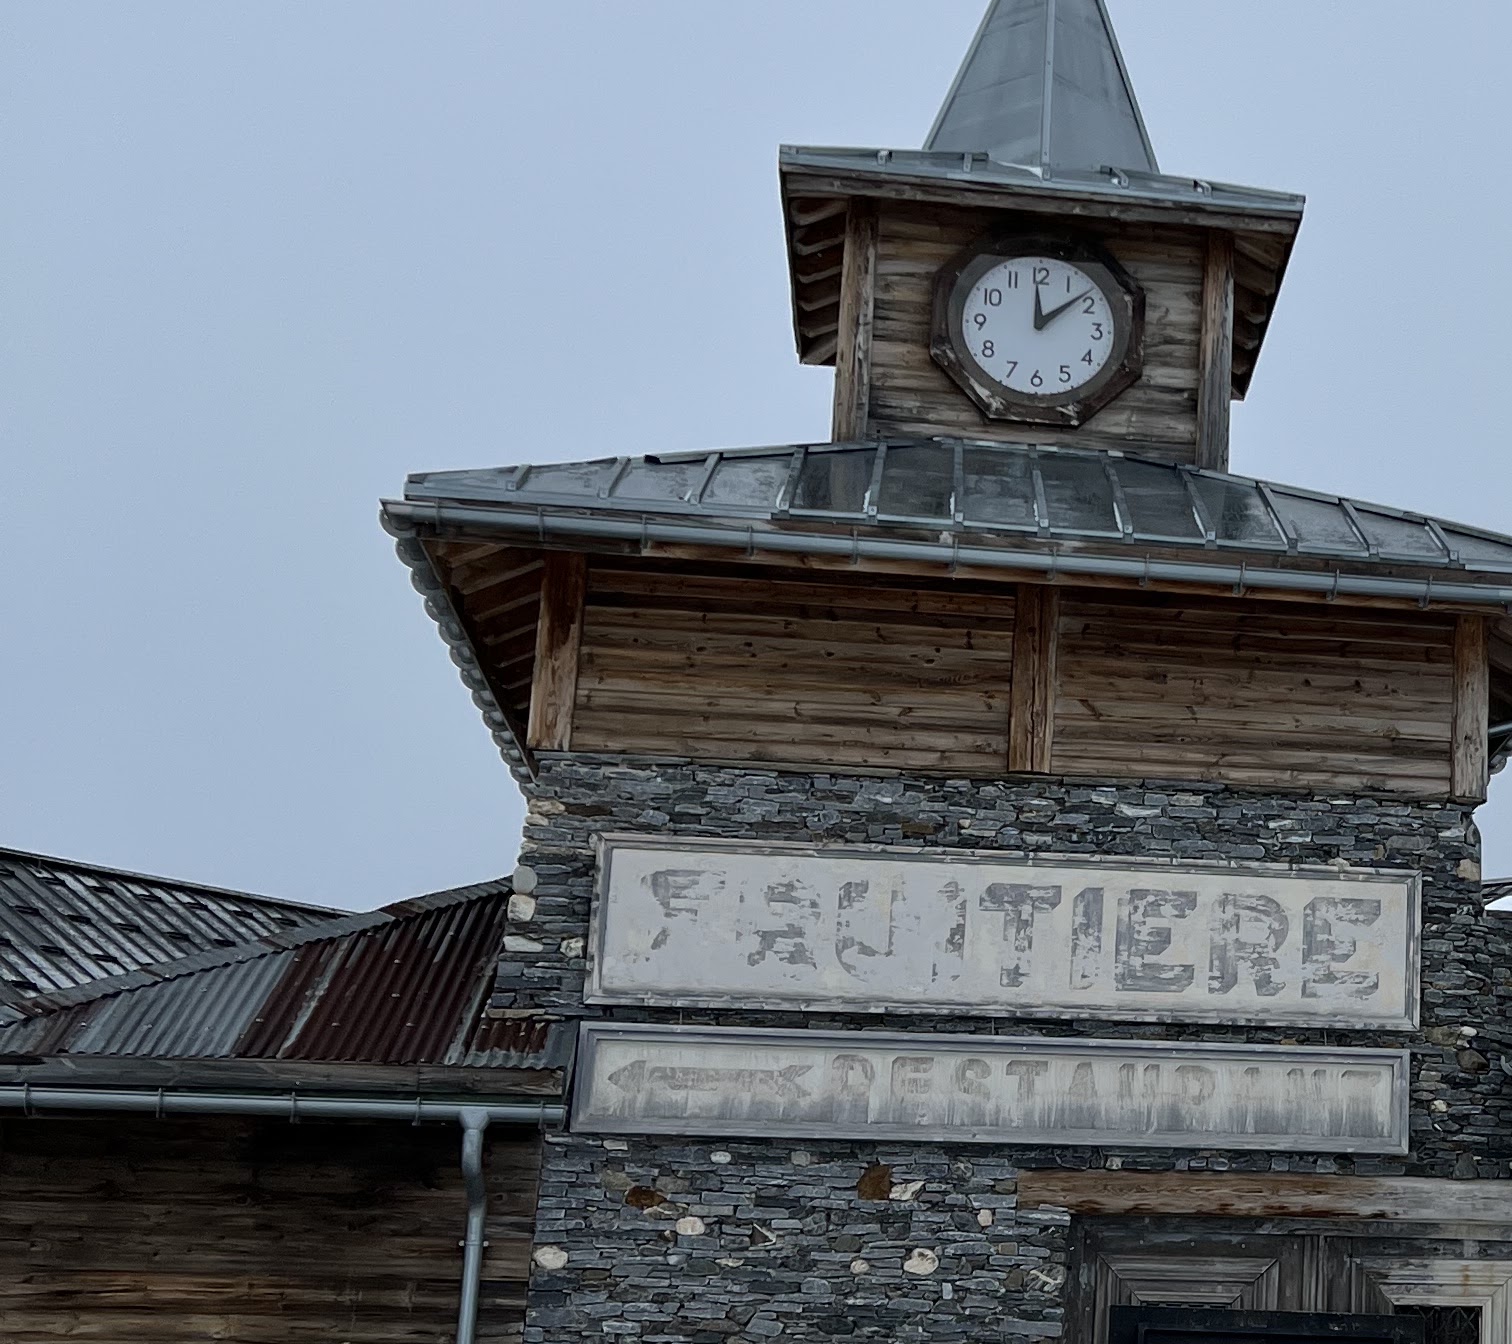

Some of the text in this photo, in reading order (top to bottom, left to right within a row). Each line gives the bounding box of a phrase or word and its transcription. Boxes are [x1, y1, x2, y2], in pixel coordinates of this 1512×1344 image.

[1008, 270, 1019, 289] 11
[1032, 267, 1050, 286] 12
[1066, 275, 1071, 294] 1
[983, 288, 1002, 307] 10
[1082, 296, 1096, 315] 2
[974, 313, 987, 331] 9
[1090, 322, 1103, 341] 3
[981, 339, 995, 358] 8
[1081, 348, 1093, 366] 4
[1006, 360, 1019, 379] 7
[1030, 369, 1043, 387] 6
[1058, 364, 1071, 383] 5
[831, 1053, 1382, 1130] RESTAURT
